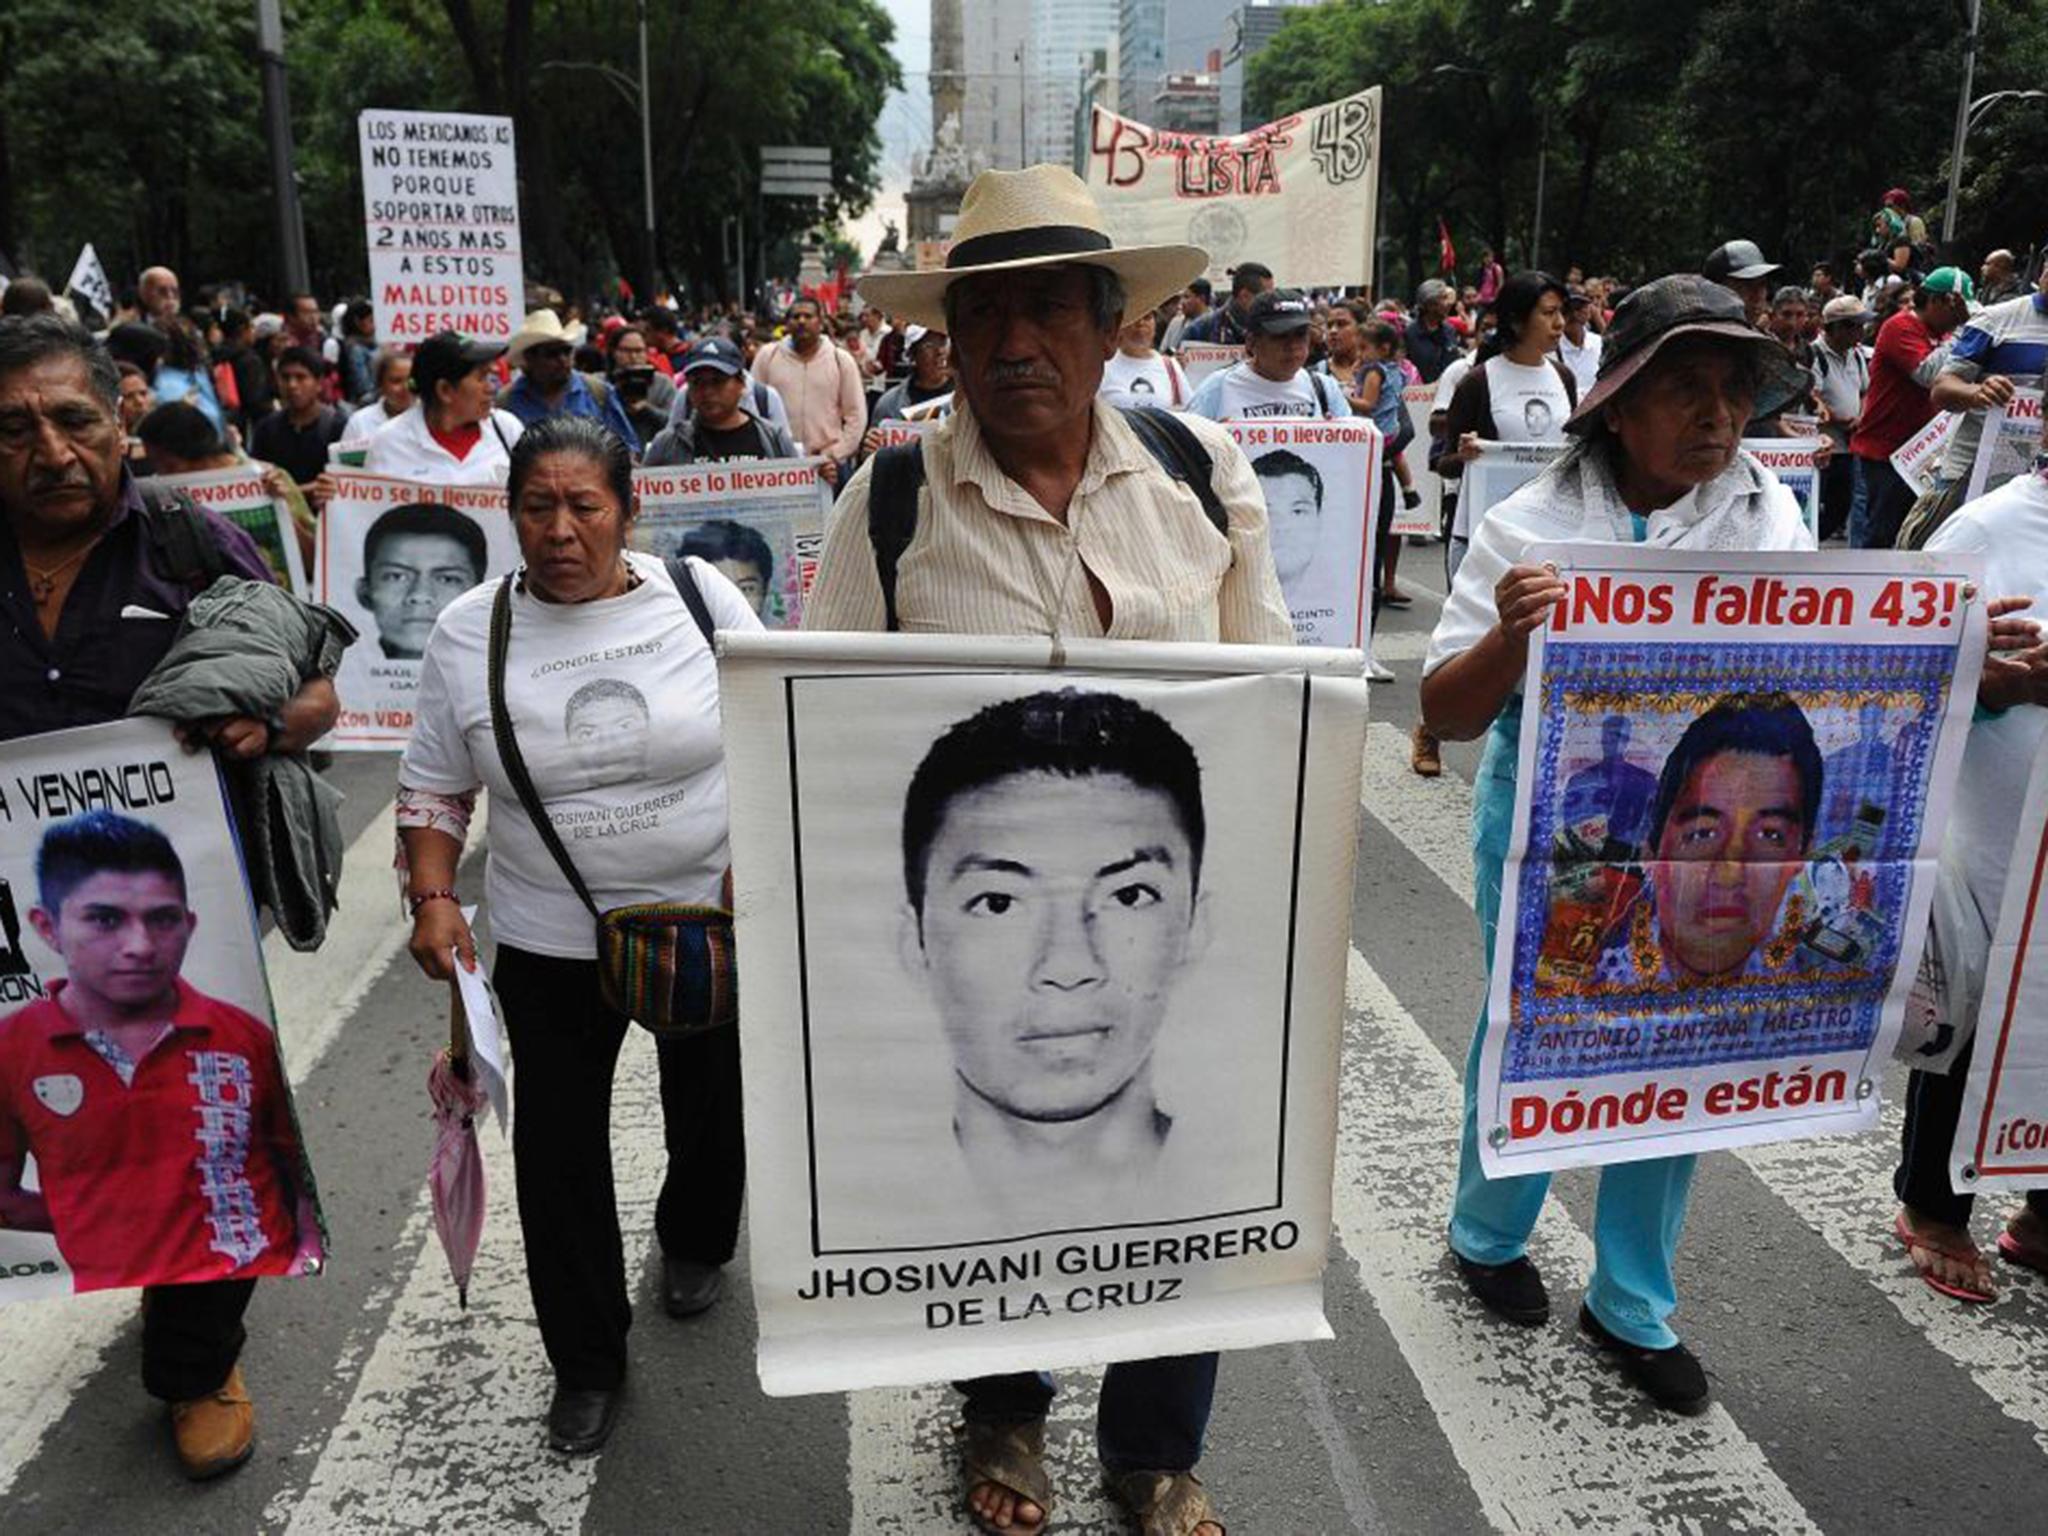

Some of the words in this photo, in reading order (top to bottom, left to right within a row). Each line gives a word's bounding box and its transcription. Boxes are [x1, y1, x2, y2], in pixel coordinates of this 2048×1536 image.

[368, 121, 396, 140] LOS
[403, 122, 488, 144] MEXICANOS
[1311, 95, 1375, 187] 43
[373, 146, 400, 168] NO
[408, 149, 492, 169] TENEMOS
[1092, 107, 1149, 187] 43
[392, 175, 476, 196] PORQUE
[1177, 149, 1281, 197] LISTA
[373, 201, 465, 221] SOPORTAR
[473, 205, 515, 224] OTROS
[376, 227, 394, 247] 2
[459, 231, 507, 250] MAS
[401, 257, 412, 274] A
[424, 256, 494, 276] ESTOS
[384, 284, 508, 307] MALDITOS
[391, 312, 511, 336] ASESINOS
[1247, 428, 1267, 445] se
[1273, 427, 1288, 443] lo
[337, 479, 382, 501] Vivo
[390, 485, 411, 503] se
[418, 487, 436, 504] lo
[680, 477, 701, 494] se
[708, 473, 725, 492] lo
[731, 468, 816, 491] llevaron!
[1552, 576, 1674, 632] ¡Nos
[1692, 576, 1854, 627] faltan
[1869, 581, 1957, 628] 43!
[604, 641, 662, 661] ESTAS?
[374, 711, 413, 728] VIDA
[17, 761, 175, 820] VENANCIO
[614, 789, 685, 820] GUERRERO
[573, 826, 593, 840] DE
[598, 824, 617, 837] LA
[620, 814, 660, 834] CRUZ
[1537, 1027, 1640, 1050] ANTONIO
[1653, 1017, 1748, 1044] SANTANA
[1761, 1007, 1851, 1033] MAESTRO
[1510, 1082, 1689, 1140] Dónde
[1704, 1066, 1848, 1116] están
[798, 1248, 1041, 1301] JHOSIVANI
[1057, 1220, 1299, 1276] GUERRERO
[926, 1299, 984, 1329] DE
[999, 1292, 1051, 1321] LA
[1066, 1278, 1183, 1314] CRUZ
